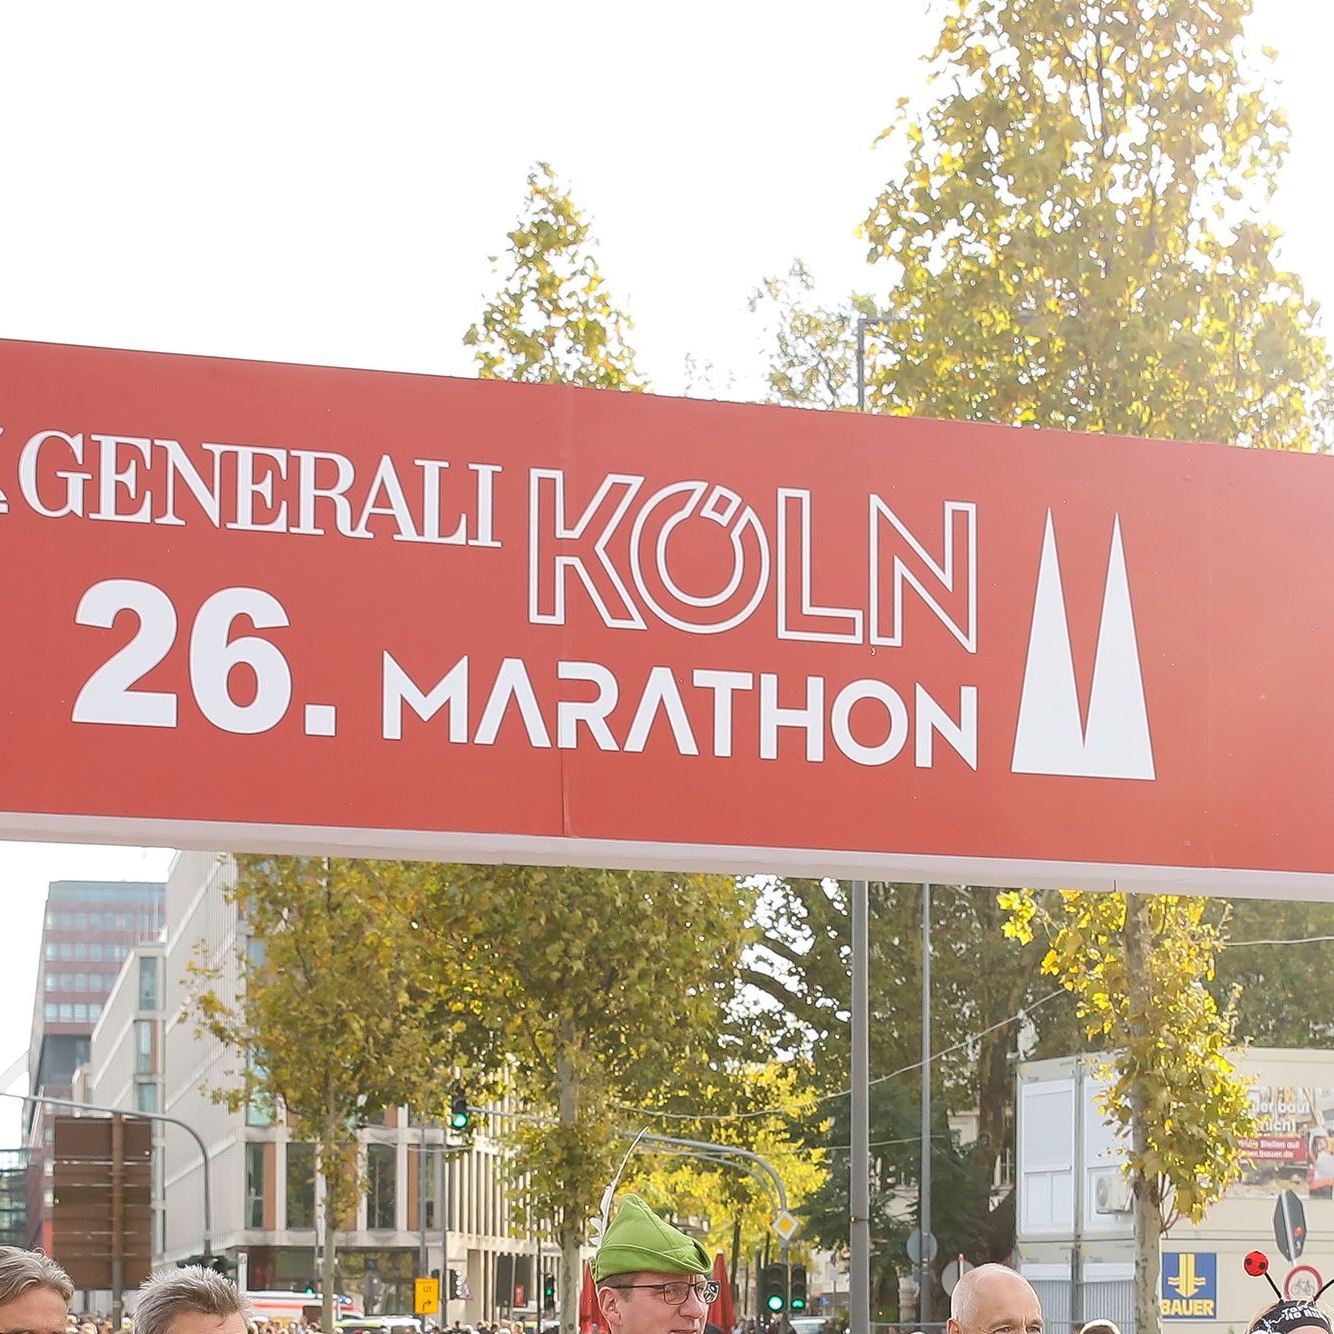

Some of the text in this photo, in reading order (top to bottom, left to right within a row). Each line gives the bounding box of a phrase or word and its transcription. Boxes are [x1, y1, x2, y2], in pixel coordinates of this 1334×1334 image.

[18, 430, 503, 548] GENERALI
[528, 466, 978, 654] KÖLN
[71, 578, 979, 773] 26. MARATHON
[1160, 1299, 1215, 1316] BAUER
